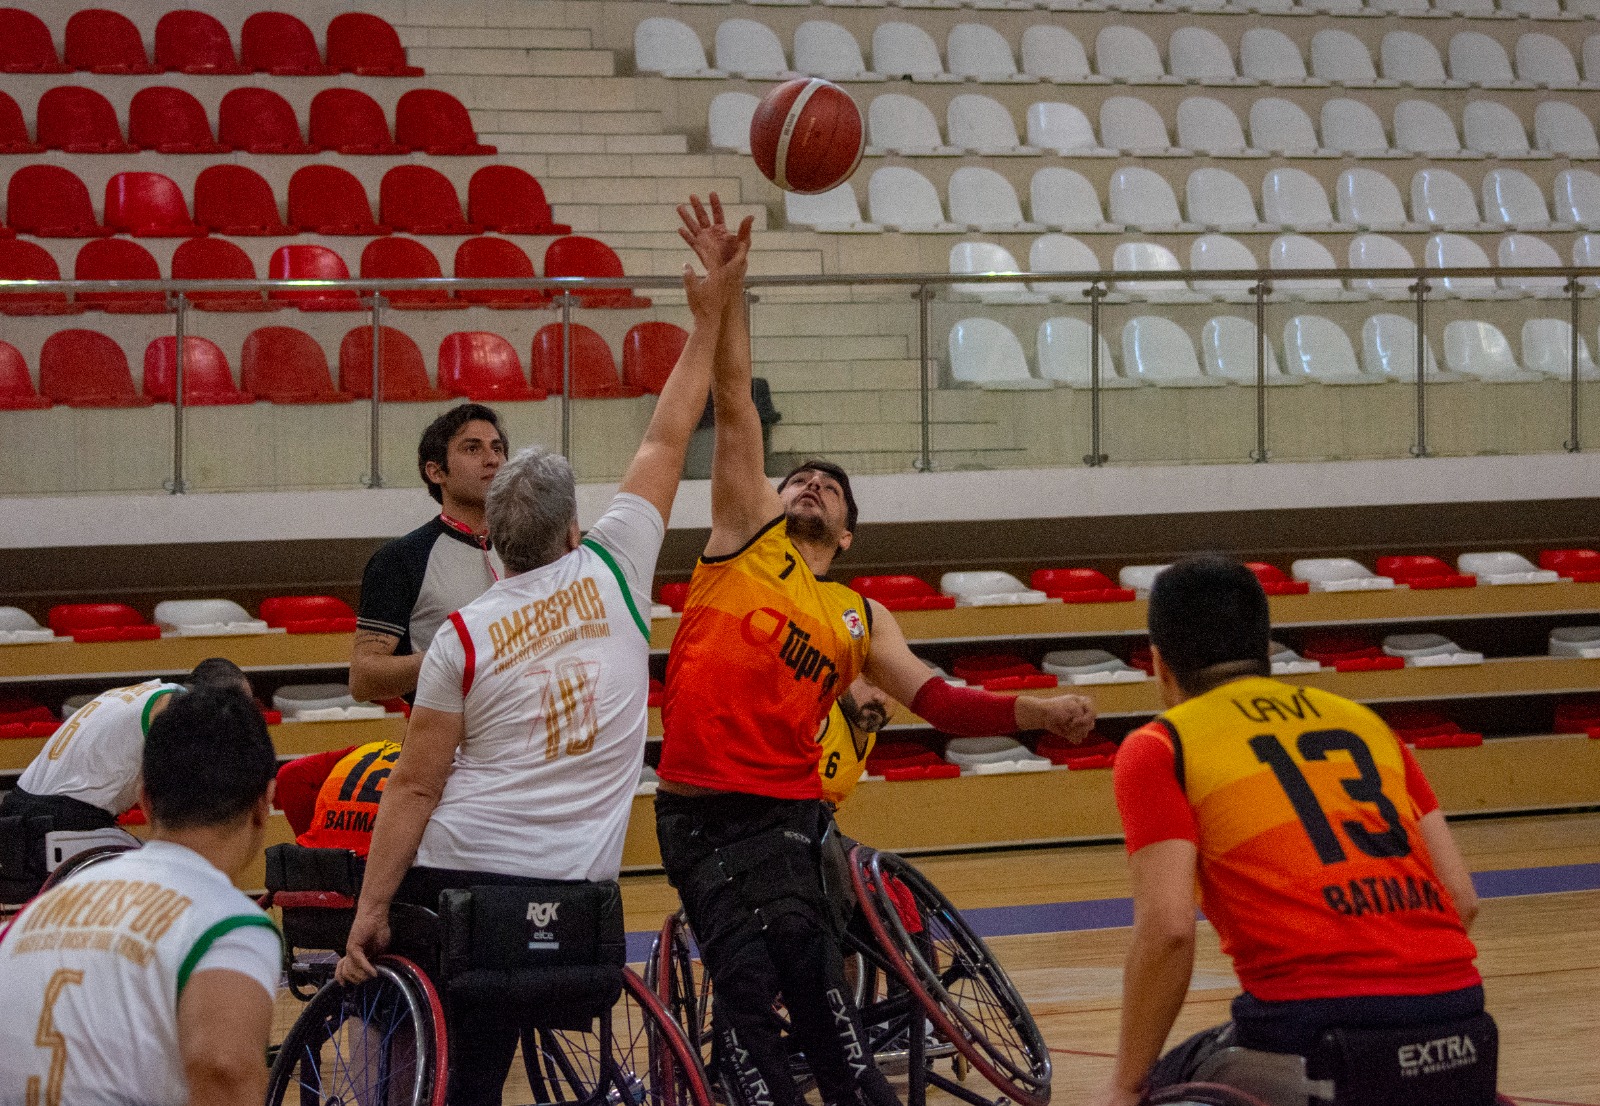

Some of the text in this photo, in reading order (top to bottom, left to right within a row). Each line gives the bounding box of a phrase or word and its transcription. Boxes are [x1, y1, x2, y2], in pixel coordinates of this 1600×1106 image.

[778, 551, 796, 580] 7
[487, 577, 607, 660] AMEDSPOR
[48, 701, 102, 760] 6
[825, 751, 840, 778] 6
[1248, 728, 1411, 865] 13
[1322, 876, 1445, 917] BATMAN
[25, 967, 85, 1106] 5
[1398, 1034, 1477, 1068] EXTRA
